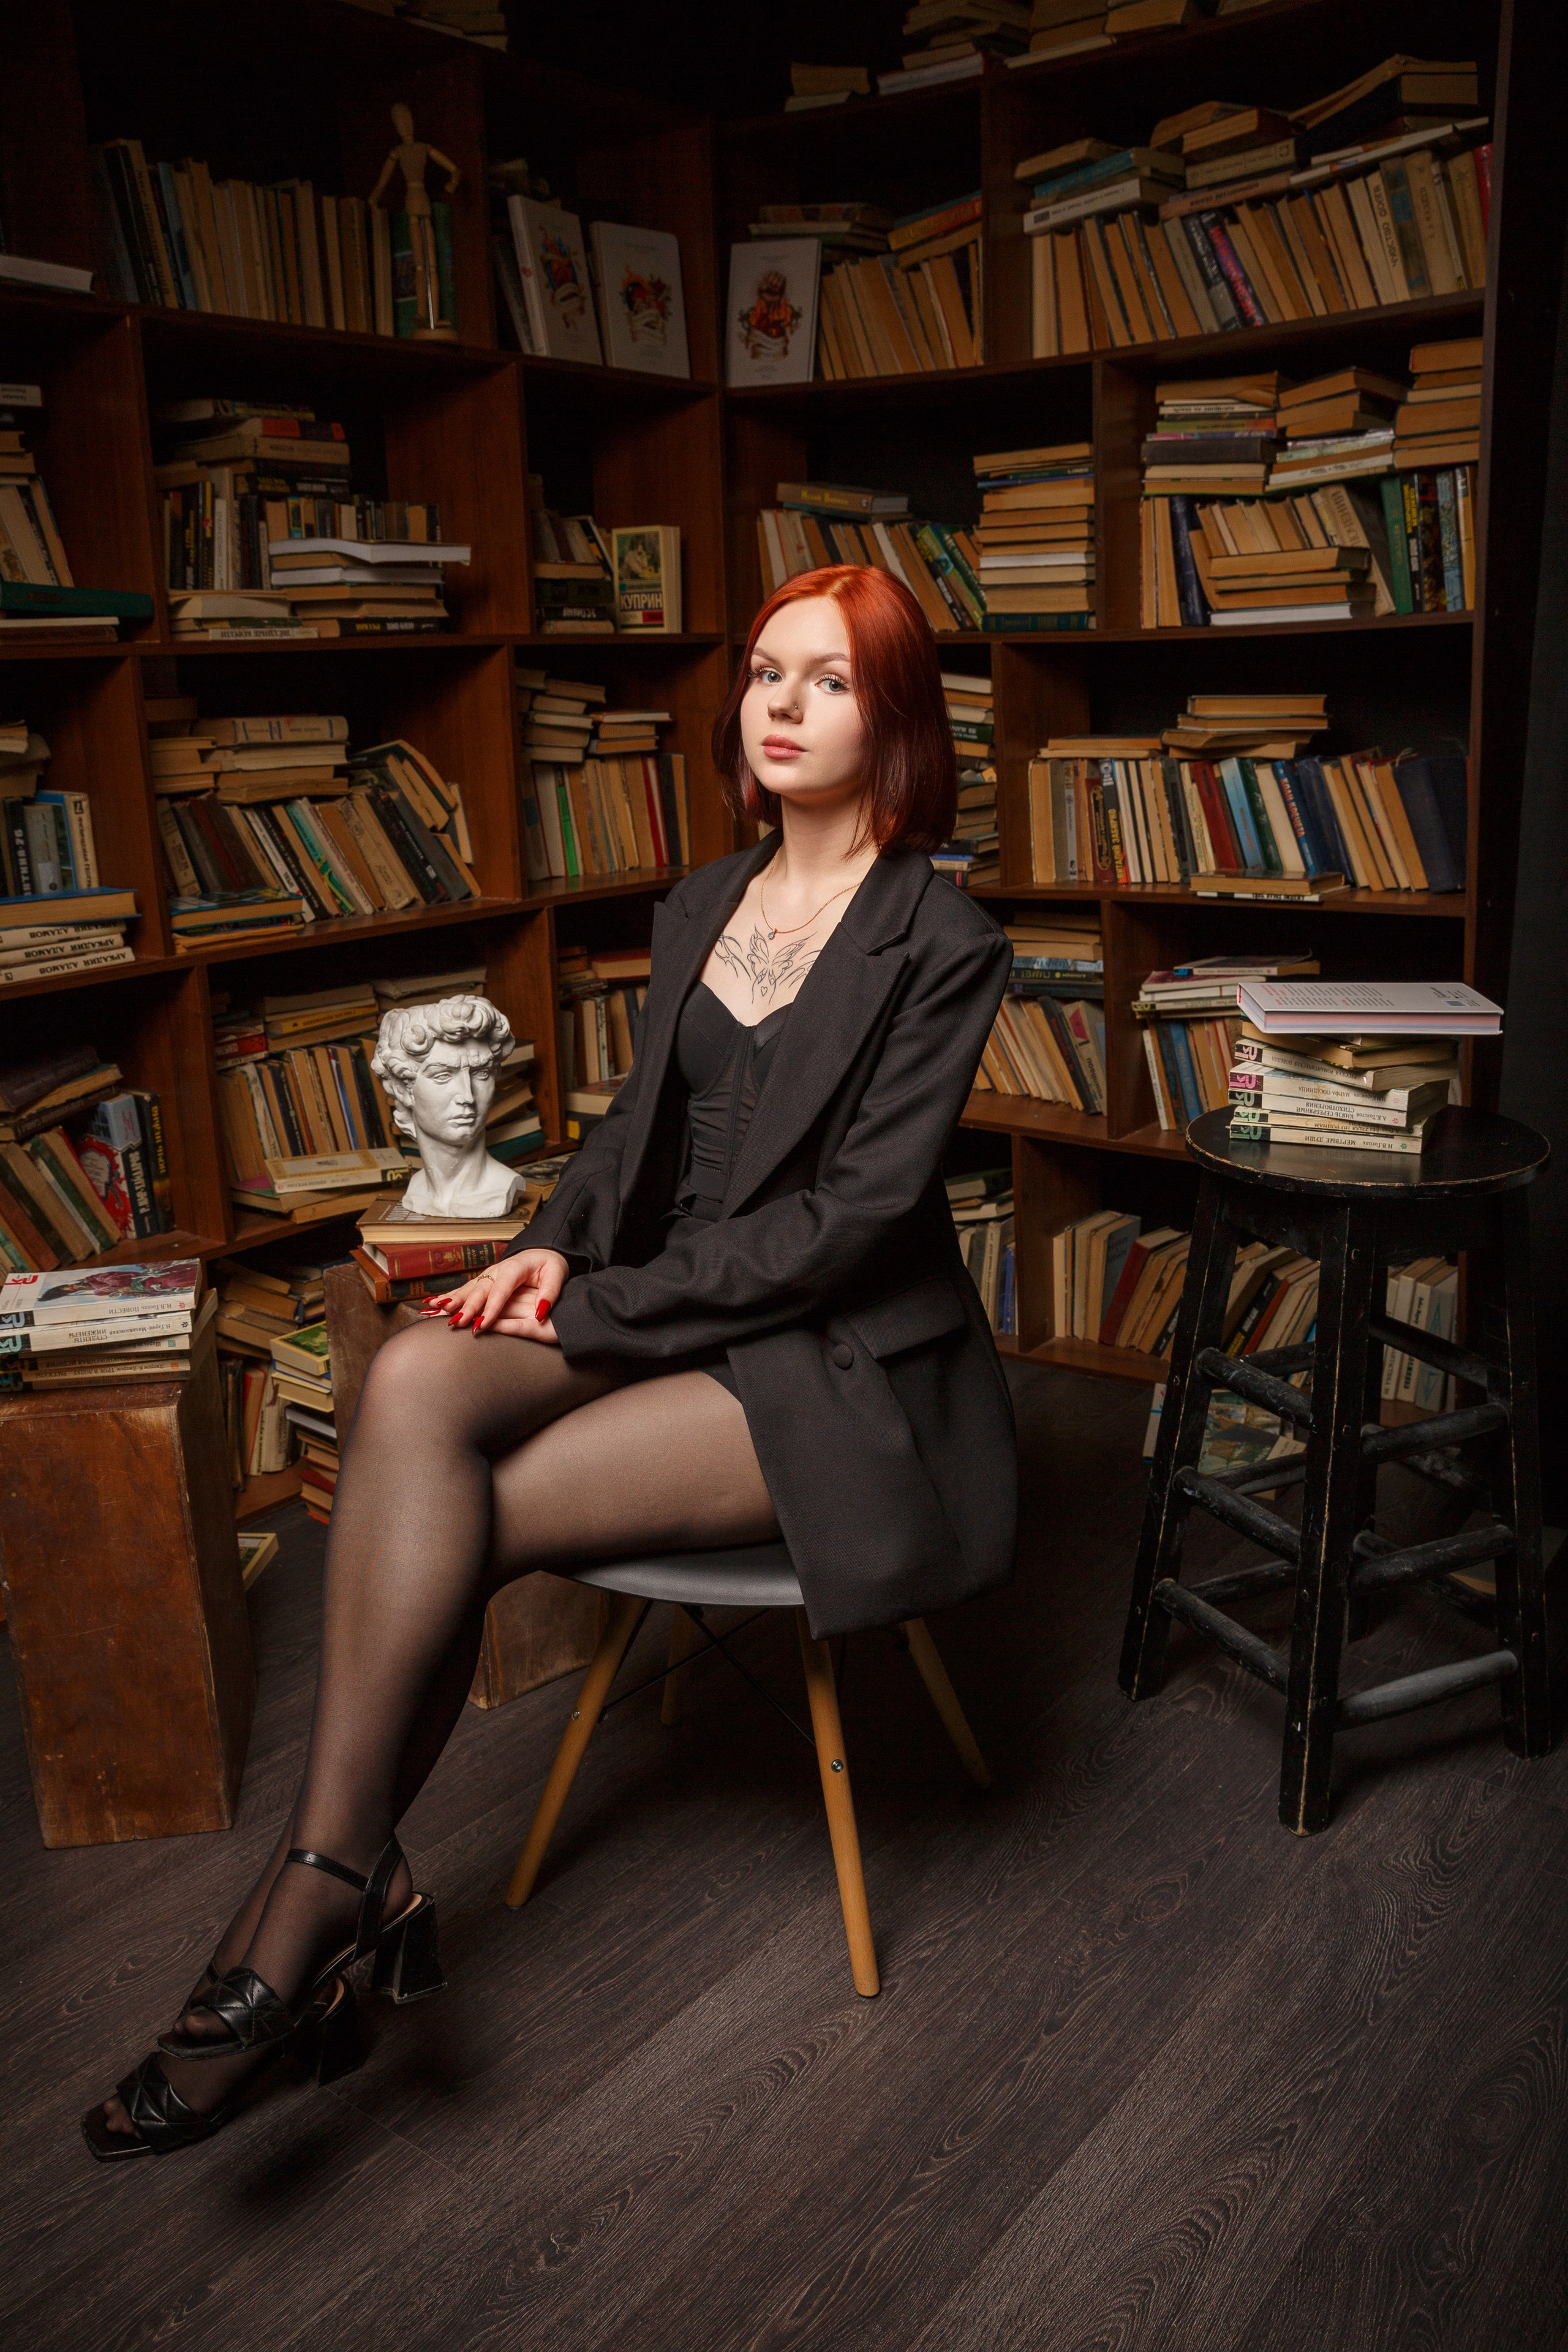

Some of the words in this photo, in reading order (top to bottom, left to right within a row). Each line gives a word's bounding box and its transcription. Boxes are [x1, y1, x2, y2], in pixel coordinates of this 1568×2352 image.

[620, 592, 663, 611] КУПРИН
[1109, 809, 1121, 843] ЗАБИРКО
[1115, 842, 1129, 880] ВИТАЛИЙ
[29, 927, 69, 938] АДАМОВ
[70, 939, 115, 951] АРКАДИЙ
[24, 946, 64, 958] АДАМОВ
[83, 953, 127, 967] АРКАДИЙ
[39, 962, 78, 974] АДАМОВ
[1272, 1056, 1292, 1065] НОВЕЛЛА
[1294, 1061, 1334, 1074] РОМАНТИЧЕСКАЯ
[1336, 1070, 1357, 1079] РУССКАЯ
[1298, 1086, 1350, 1096] МАРФА-ПОСАДНИЦА
[1297, 1107, 1333, 1117] СЕРЕБРЯНЫЙ
[1306, 1102, 1355, 1112] СТИХОТВОРЕНИЯ
[1356, 1112, 1387, 1121] А.К.Толстой
[69, 1329, 106, 1338] ИНЖЕНЕРЫ
[1386, 1349, 1396, 1385] АНТАСТИКА
